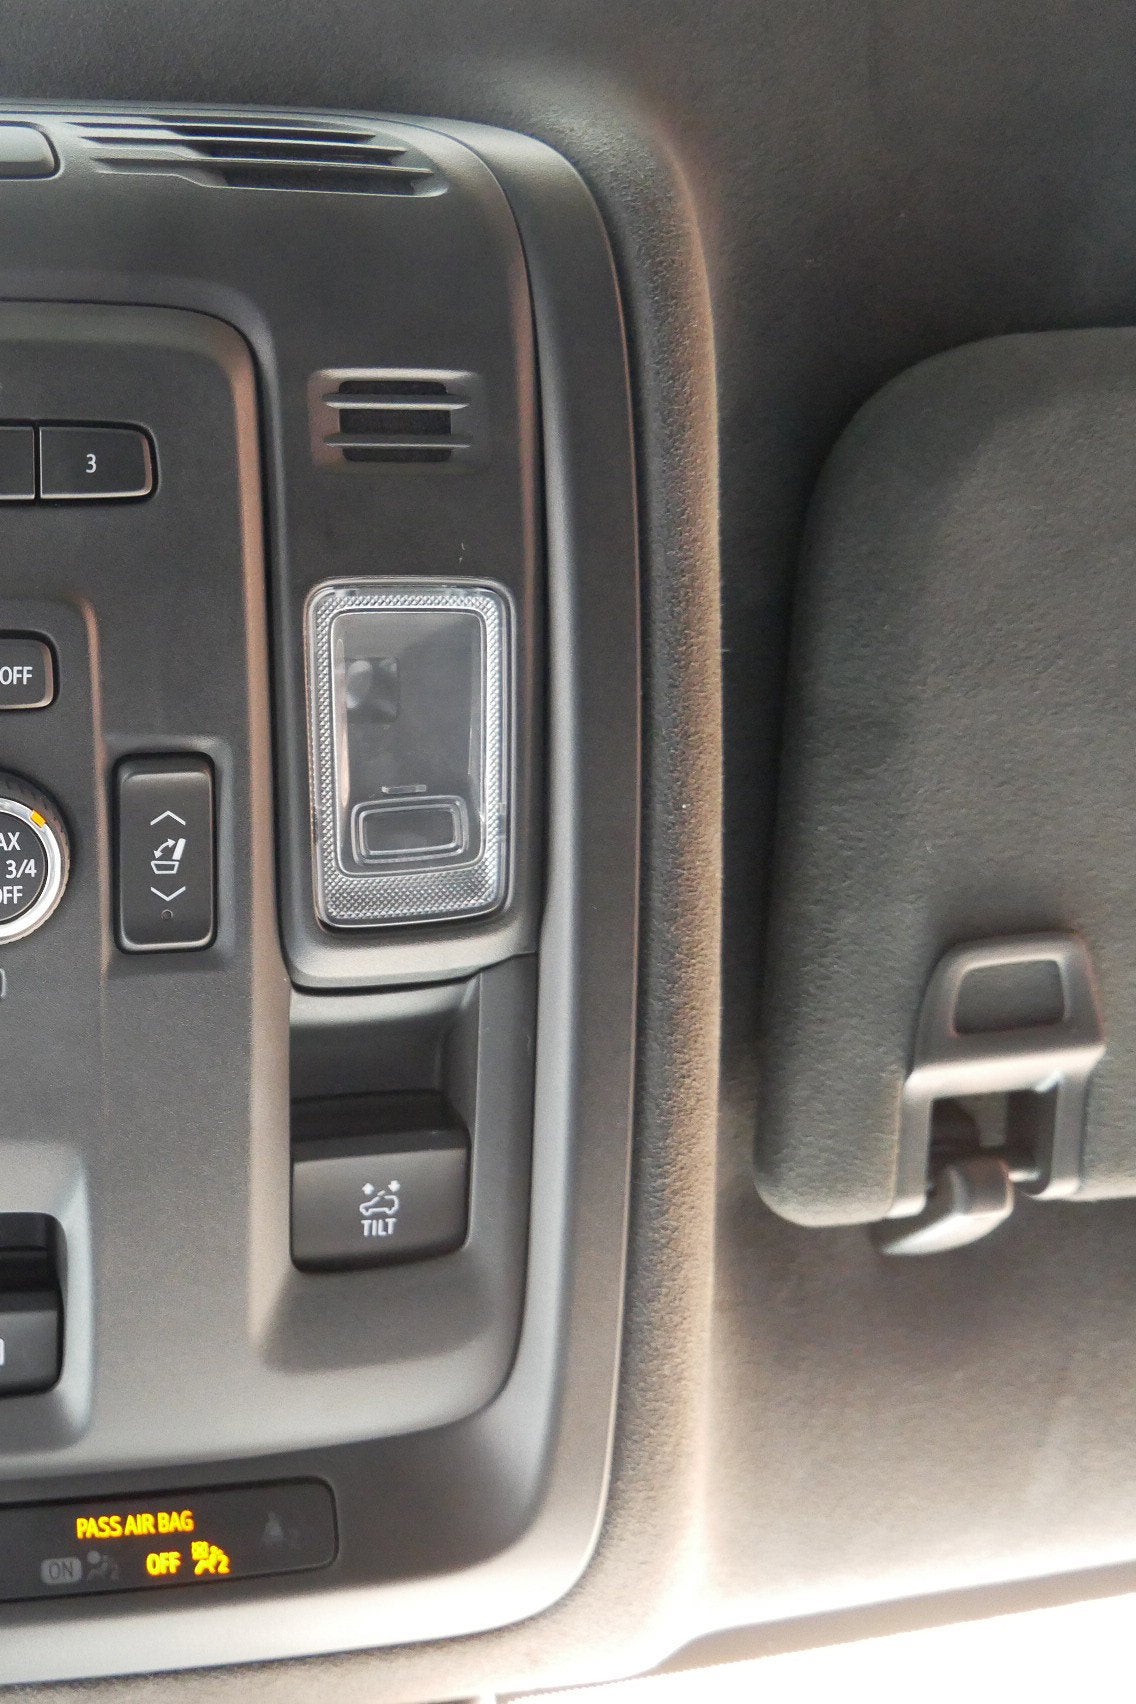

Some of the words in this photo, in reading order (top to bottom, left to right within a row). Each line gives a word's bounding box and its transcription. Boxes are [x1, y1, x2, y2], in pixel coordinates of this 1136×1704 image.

[85, 453, 97, 473] 3
[0, 666, 33, 685] OFF
[5, 858, 37, 879] 3/4
[360, 1217, 397, 1237] TILT
[76, 1515, 123, 1539] PASS
[124, 1513, 156, 1536] AIR
[157, 1509, 195, 1534] BAG
[48, 1560, 74, 1580] ON
[146, 1551, 181, 1576] OFF
